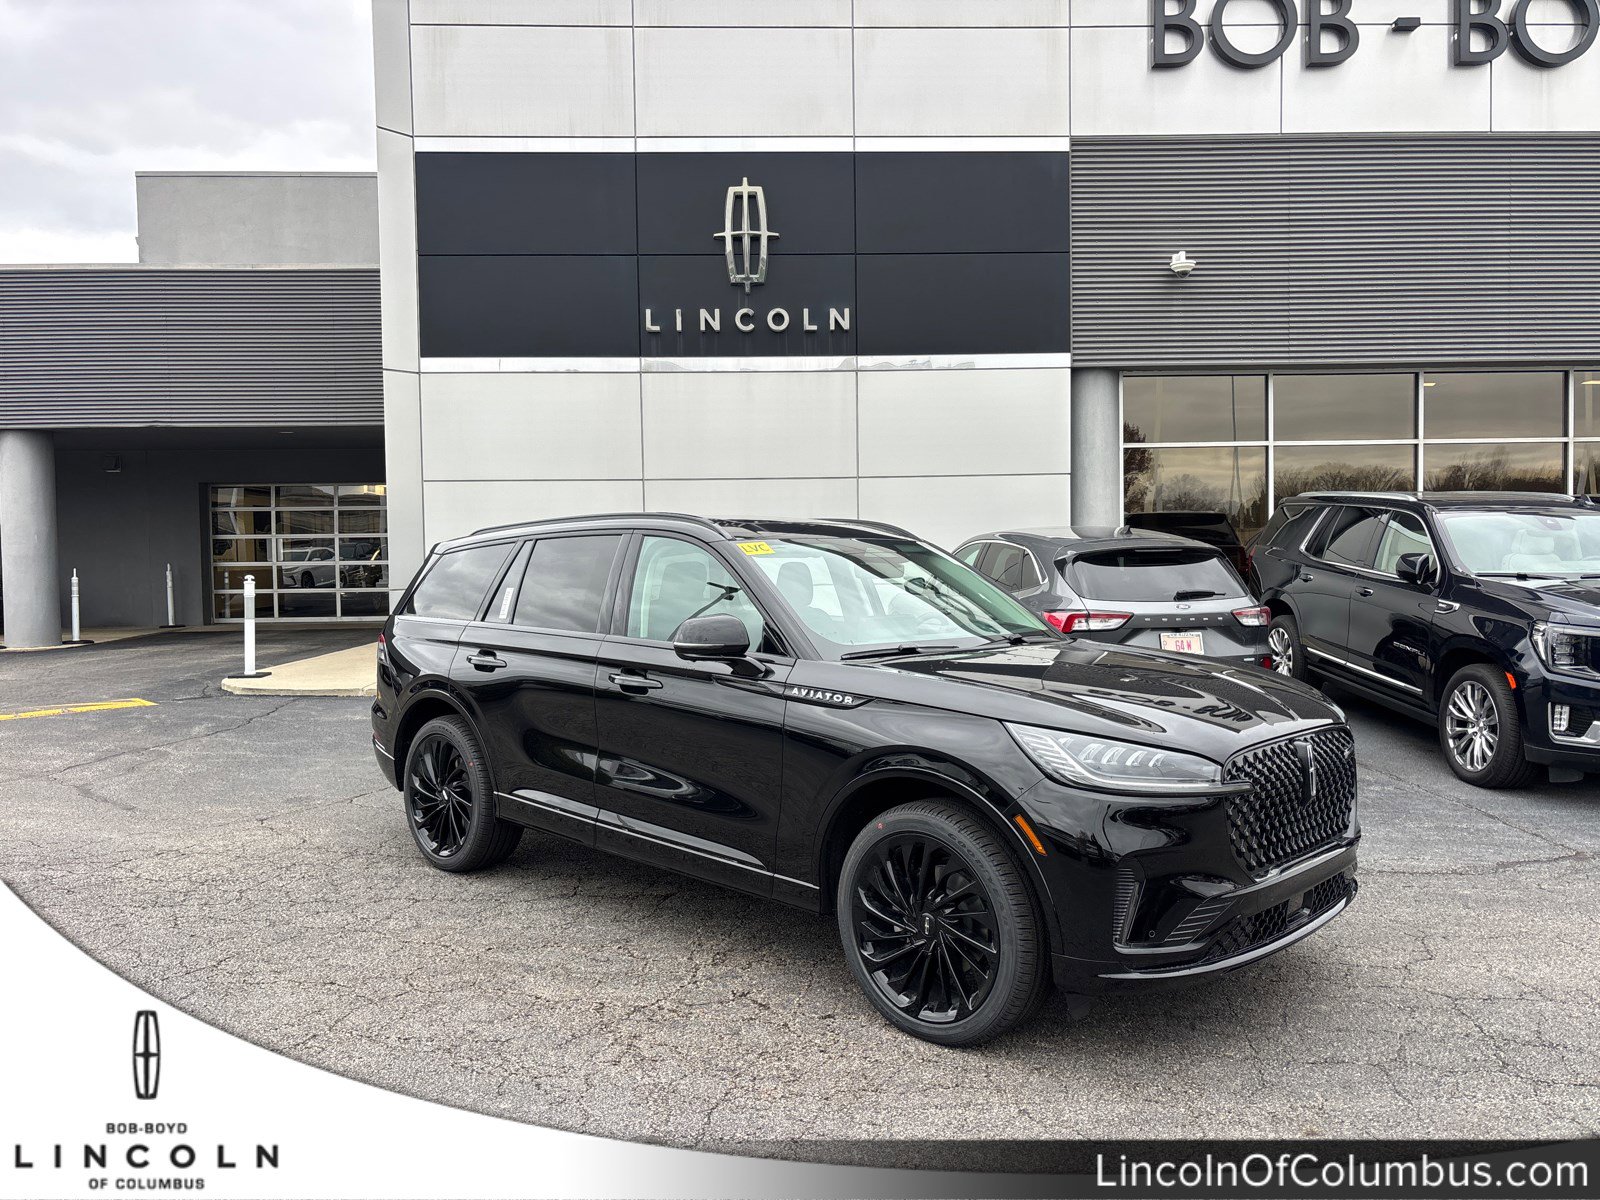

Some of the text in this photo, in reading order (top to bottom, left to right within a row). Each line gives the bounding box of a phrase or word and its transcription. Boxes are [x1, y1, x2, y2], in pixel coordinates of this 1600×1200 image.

[1151, 0, 1359, 70] BOB
[645, 307, 851, 333] LINCOLN
[791, 687, 854, 705] AVIATOR
